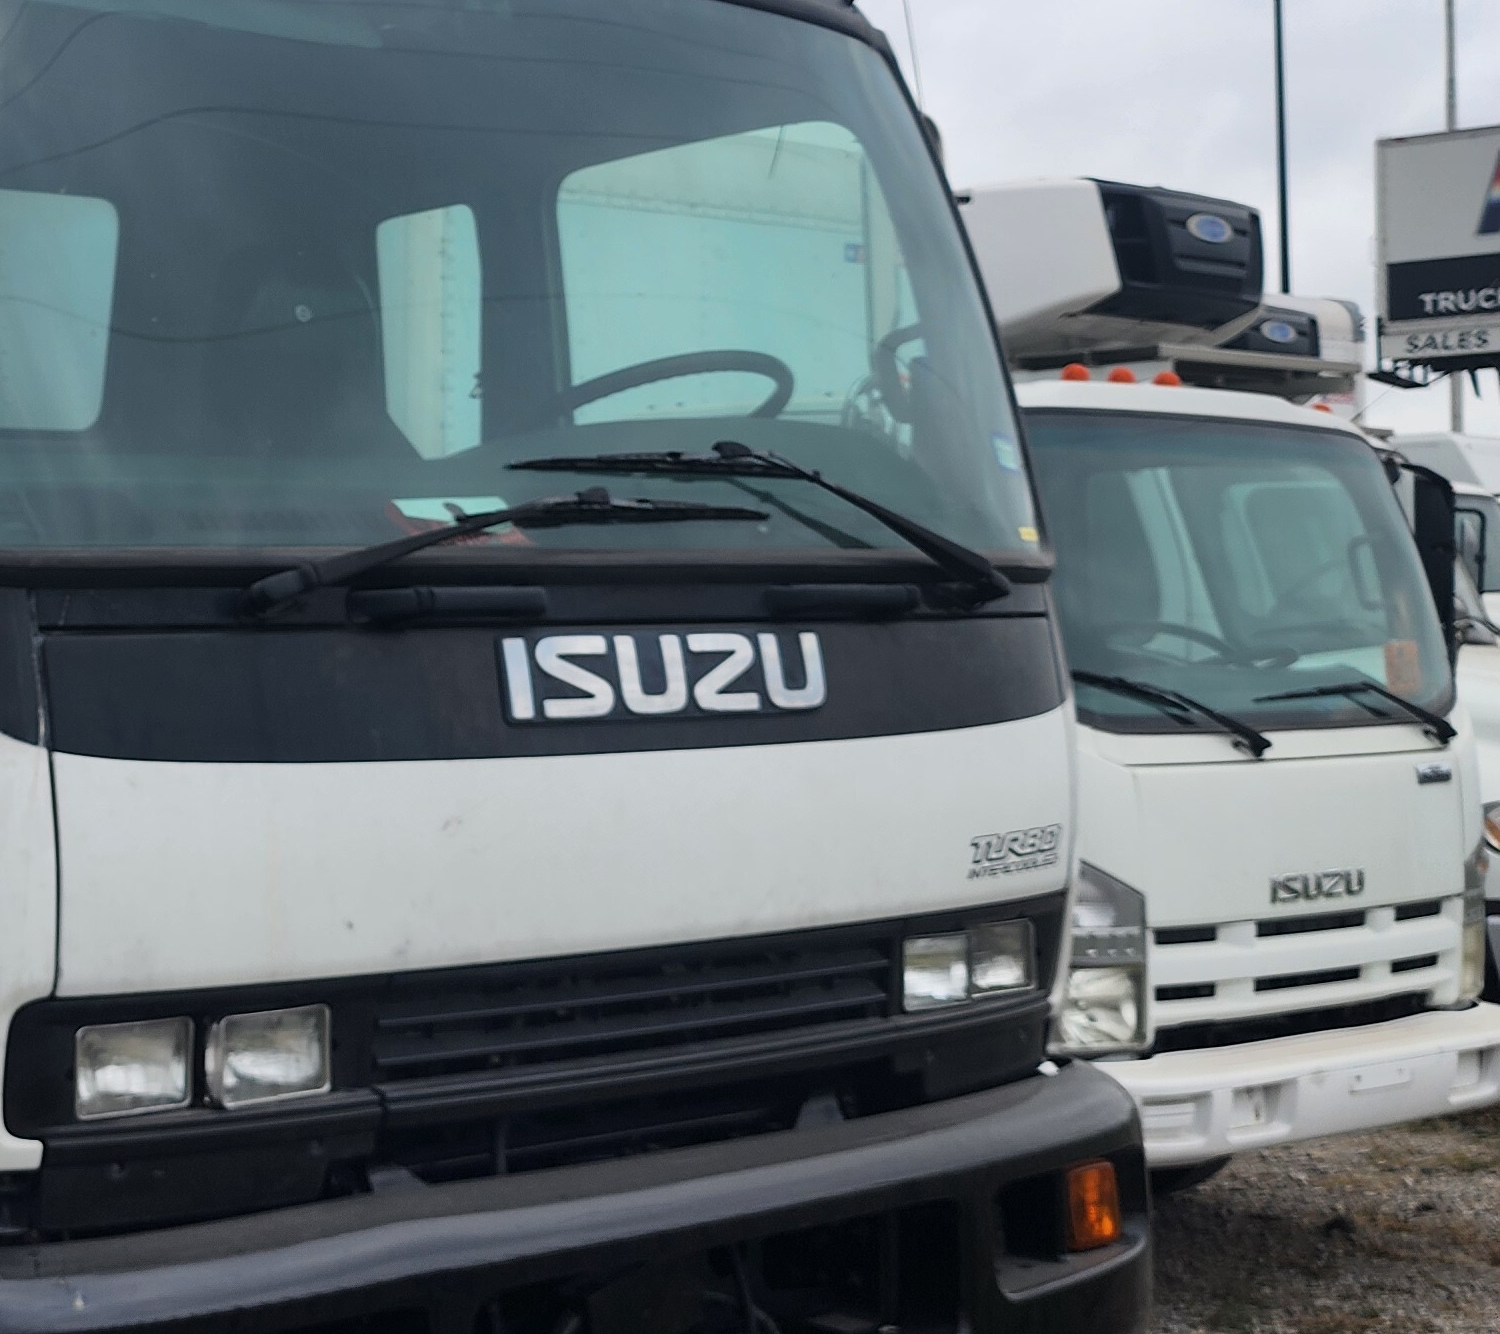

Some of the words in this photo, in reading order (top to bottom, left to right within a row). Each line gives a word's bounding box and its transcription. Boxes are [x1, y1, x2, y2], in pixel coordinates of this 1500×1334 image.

[1418, 287, 1500, 315] TRUC
[1405, 328, 1490, 354] SALES
[501, 631, 828, 721] ISUZU
[969, 822, 1063, 865] TURBO
[1269, 866, 1366, 904] ISUZU
